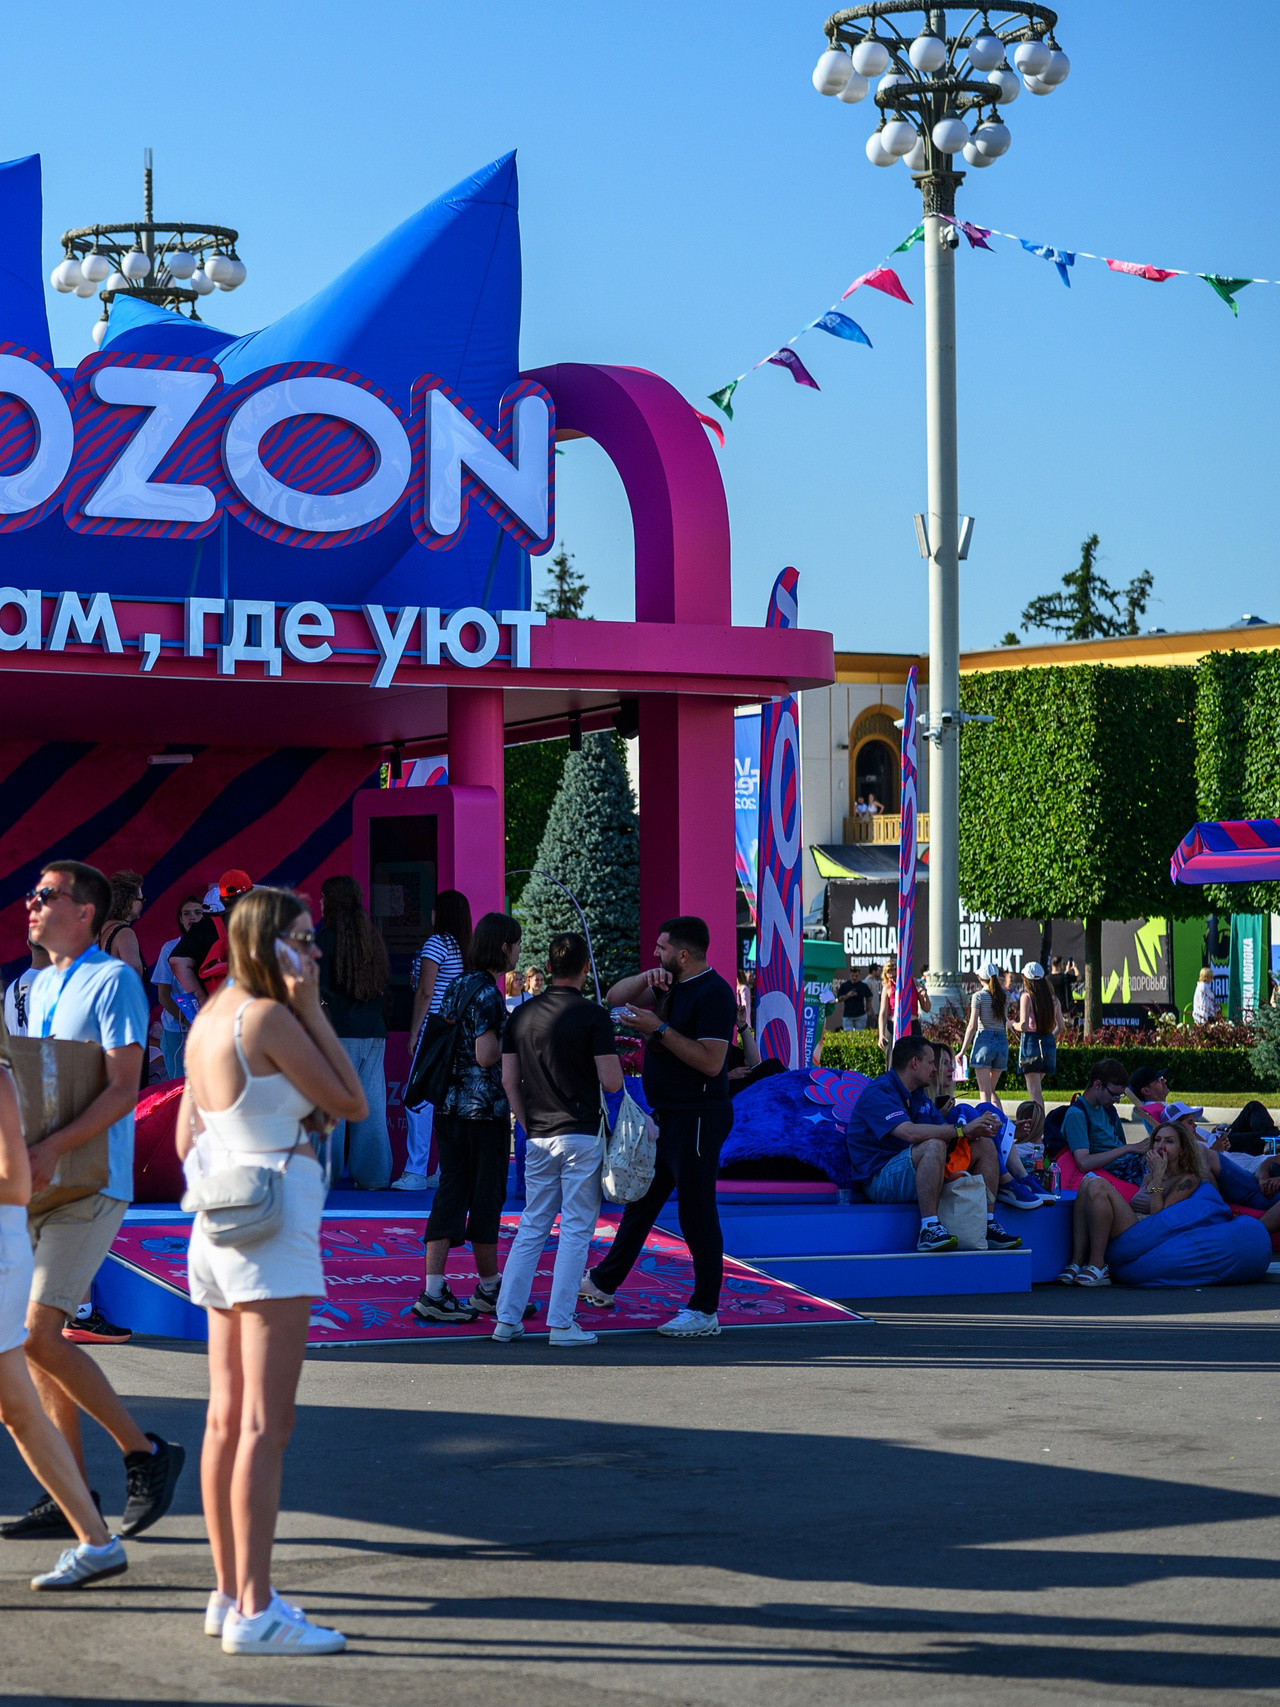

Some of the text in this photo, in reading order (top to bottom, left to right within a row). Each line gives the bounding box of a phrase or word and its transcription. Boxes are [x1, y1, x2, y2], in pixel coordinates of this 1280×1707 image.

[184, 596, 335, 676] где
[362, 604, 547, 688] уют
[844, 927, 898, 954] GORILLA
[958, 948, 1023, 973] СТИНКТ
[324, 1274, 421, 1285] Добро
